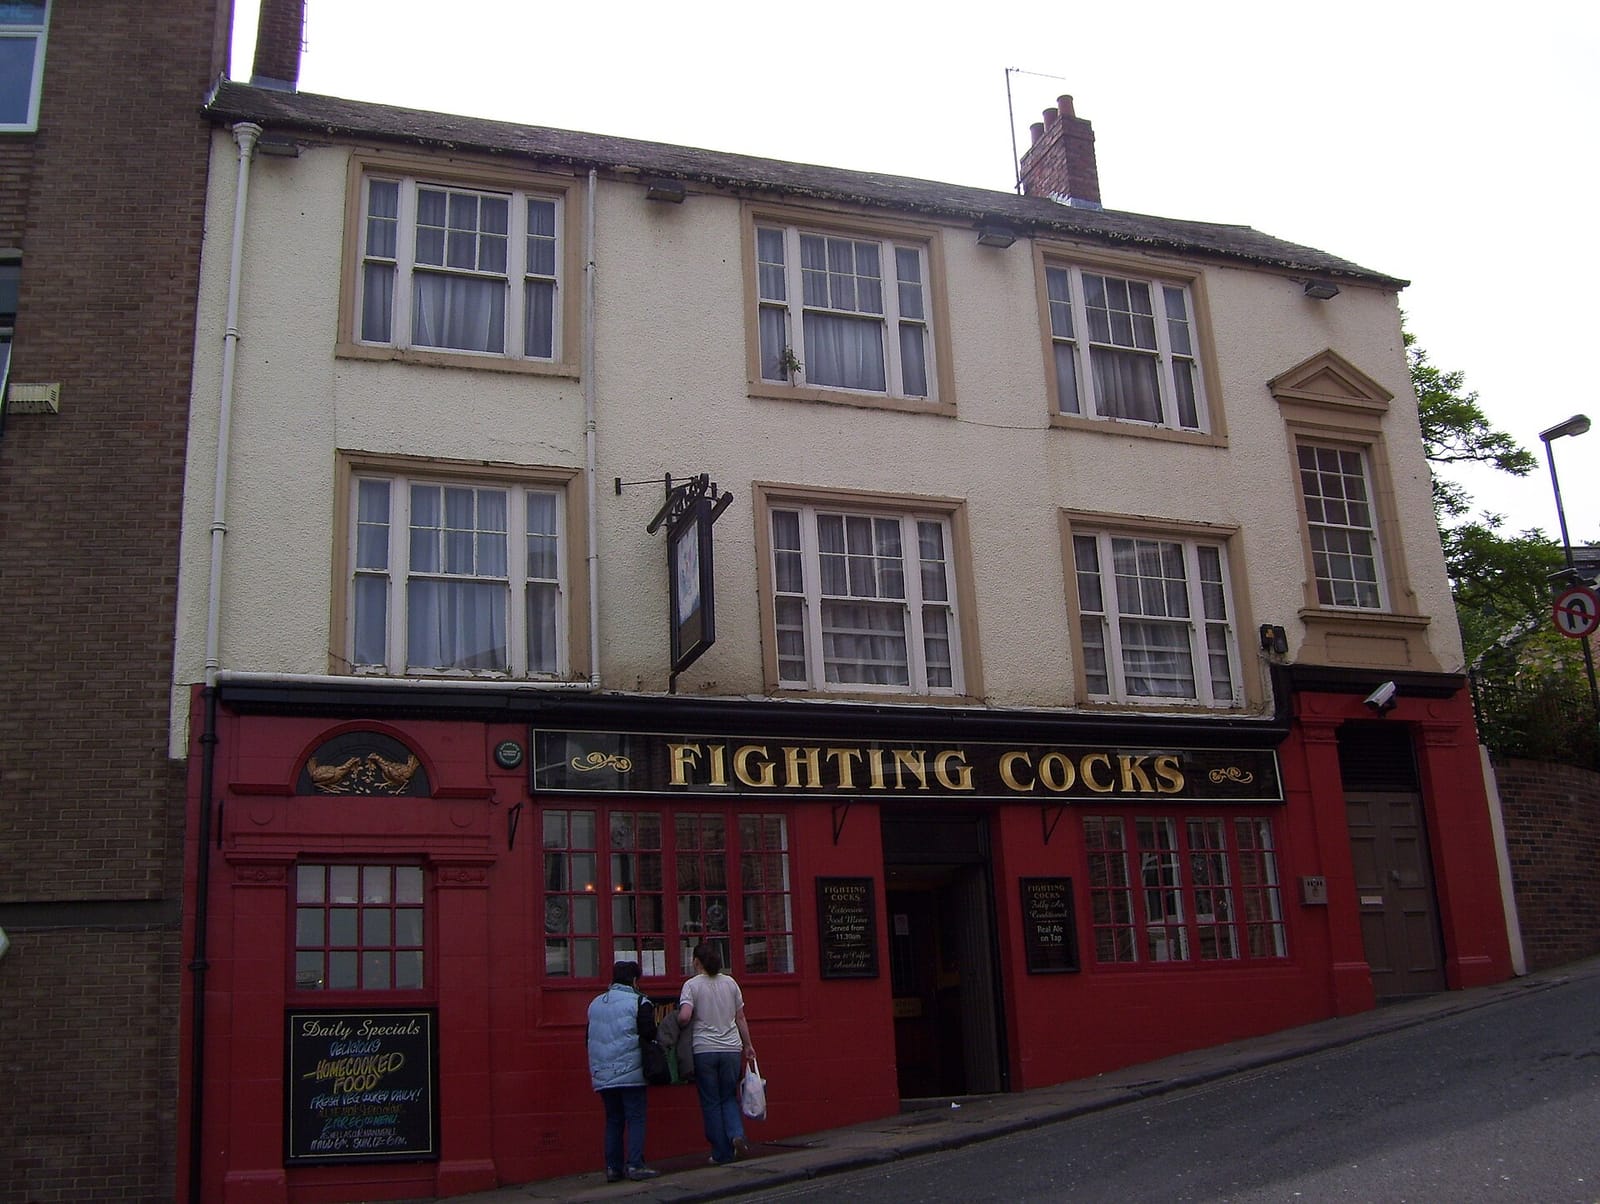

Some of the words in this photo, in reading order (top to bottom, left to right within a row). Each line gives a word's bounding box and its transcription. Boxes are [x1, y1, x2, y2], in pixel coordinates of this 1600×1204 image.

[666, 743, 976, 791] FIGHTING
[999, 751, 1186, 793] COCKS
[824, 886, 866, 894] FIGHTING
[1028, 885, 1065, 893] FIGHTING
[1037, 925, 1051, 934] Real
[1053, 925, 1063, 933] Ale
[1051, 934, 1062, 943] Tap
[302, 1020, 353, 1040] Daily
[356, 1018, 421, 1040] Specials
[329, 1038, 382, 1057] DELICIOUS
[315, 1052, 405, 1081] HOMECOOKED
[333, 1074, 379, 1094] FOOD
[310, 1093, 340, 1110] FRESH
[342, 1092, 361, 1106] VEG
